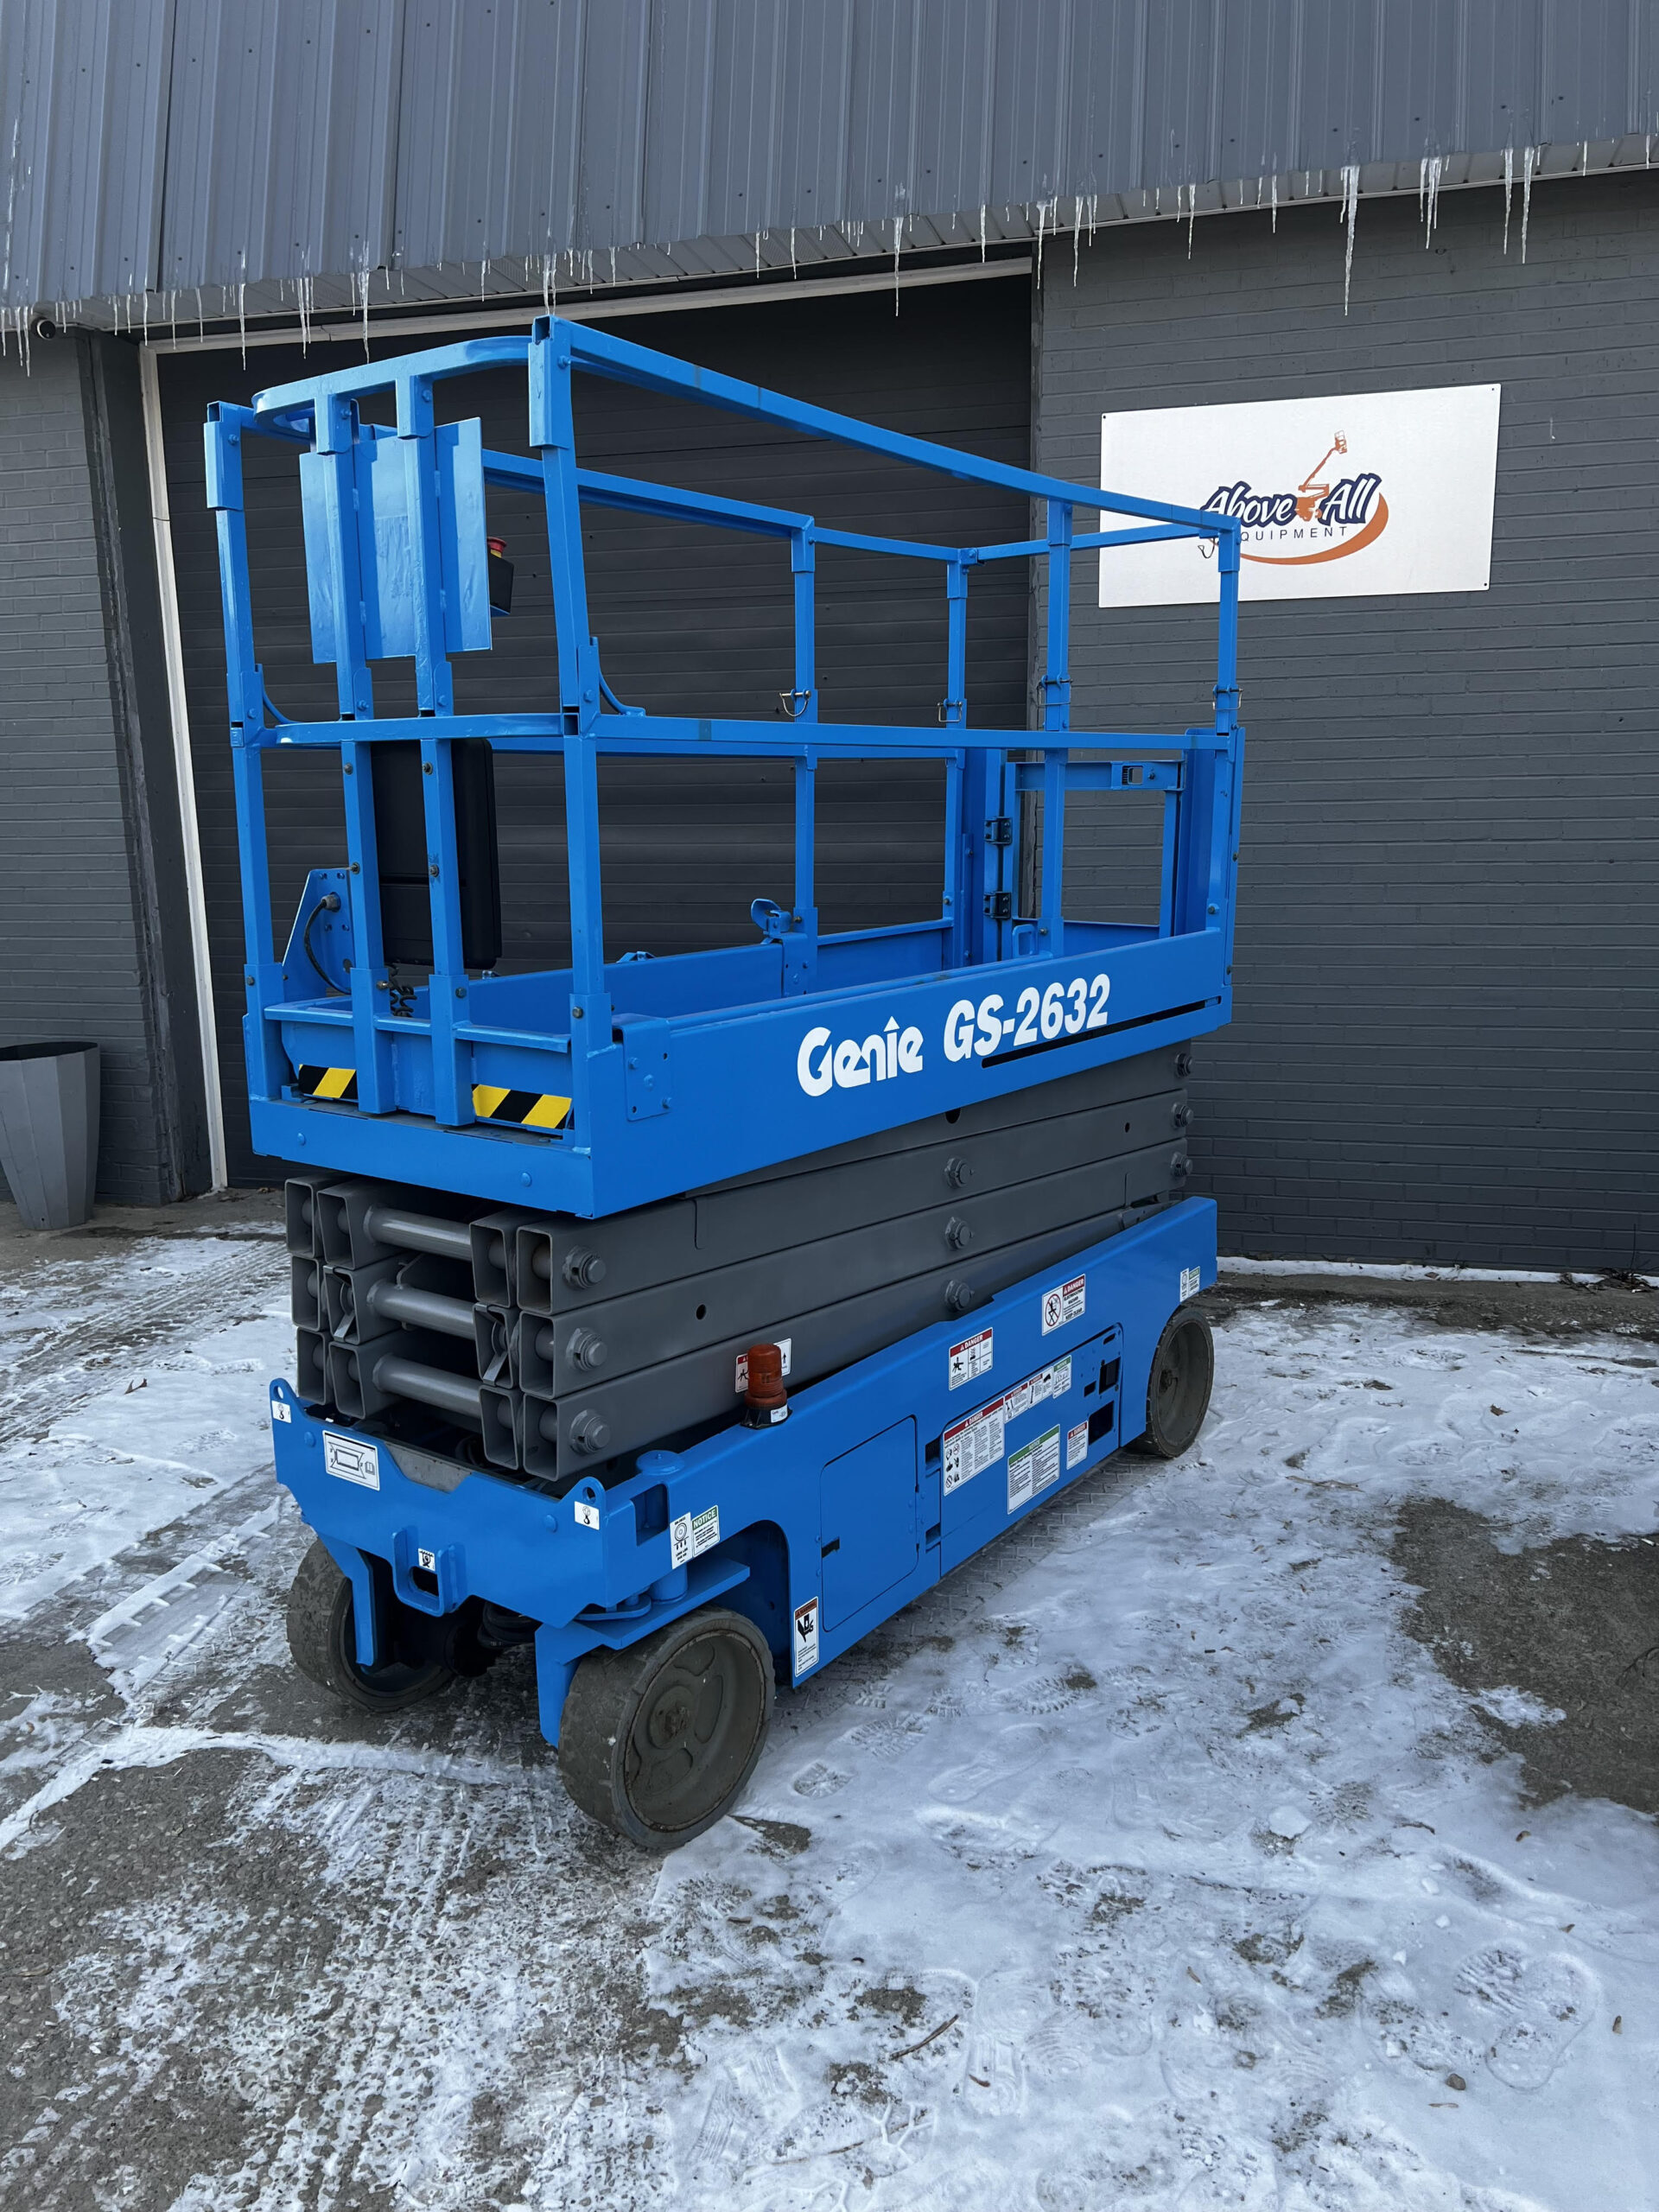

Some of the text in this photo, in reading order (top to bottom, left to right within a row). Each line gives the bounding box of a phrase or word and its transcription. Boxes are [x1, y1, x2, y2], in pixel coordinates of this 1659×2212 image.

[1202, 474, 1380, 526] Above All
[1241, 526, 1347, 542] QUIPMENT
[797, 973, 1110, 1097] Genie GS-2632
[1067, 1278, 1084, 1293] DANGER
[964, 1334, 983, 1349] DANGER
[969, 1411, 983, 1425] DANGER
[693, 1509, 716, 1529] NOTICE
